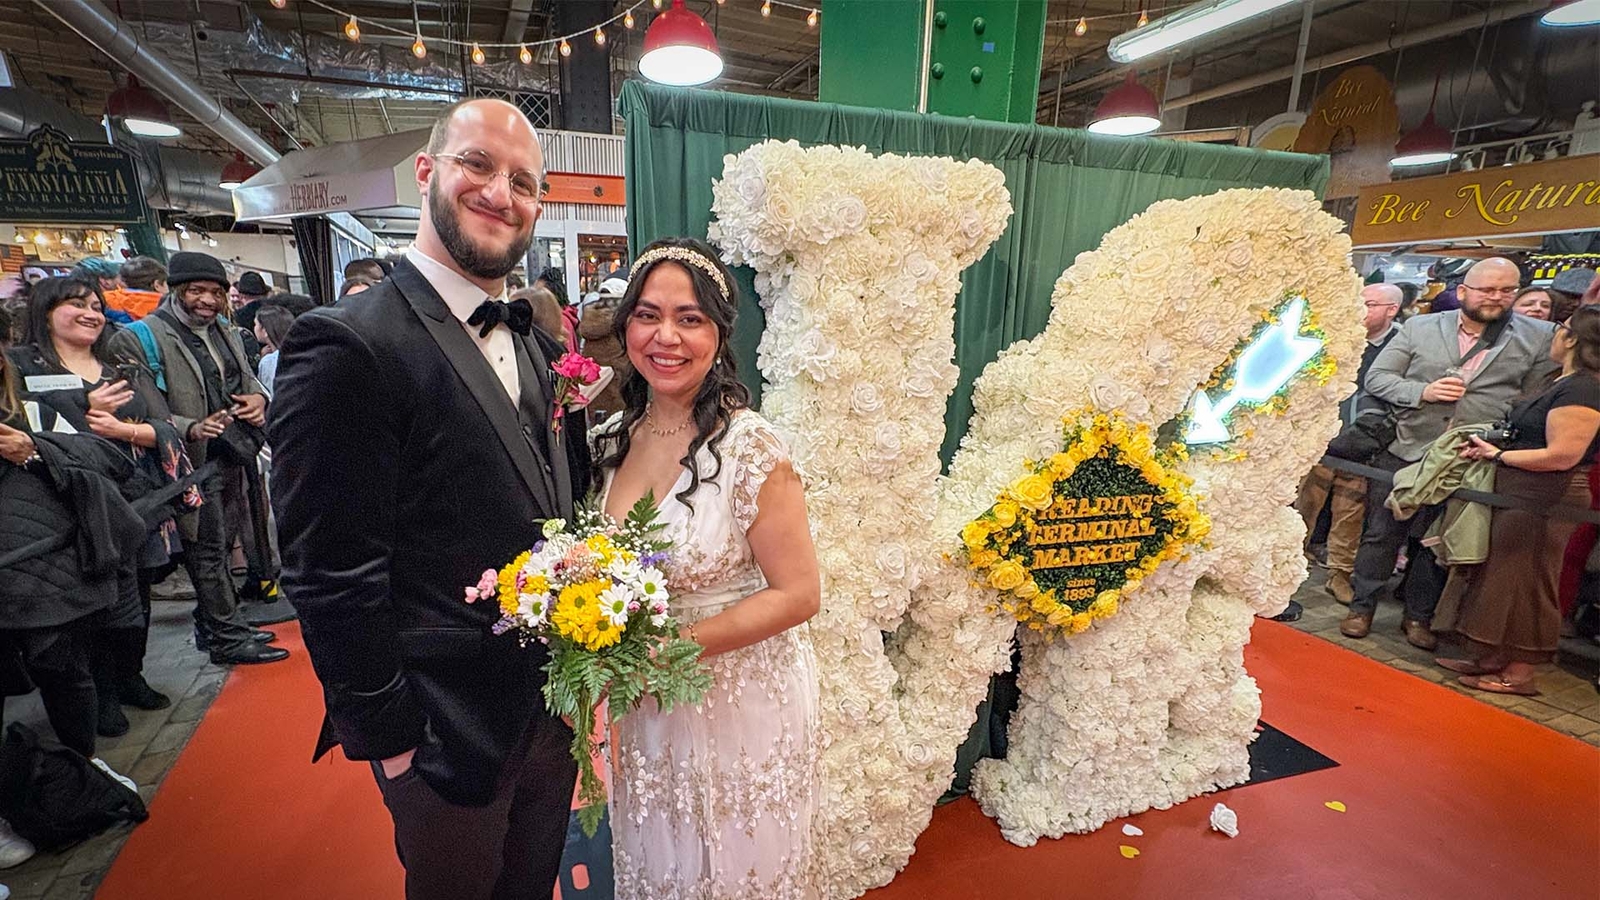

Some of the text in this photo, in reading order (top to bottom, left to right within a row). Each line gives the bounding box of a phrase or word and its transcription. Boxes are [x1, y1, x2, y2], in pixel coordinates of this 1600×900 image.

[0, 168, 128, 195] ENNSYLVANIA
[1367, 194, 1430, 226] Bee
[1037, 495, 1153, 519] READING
[1026, 517, 1156, 546] TERMINAL
[1032, 542, 1140, 570] MARKET
[1064, 588, 1095, 601] 1893
[1067, 578, 1096, 588] since
